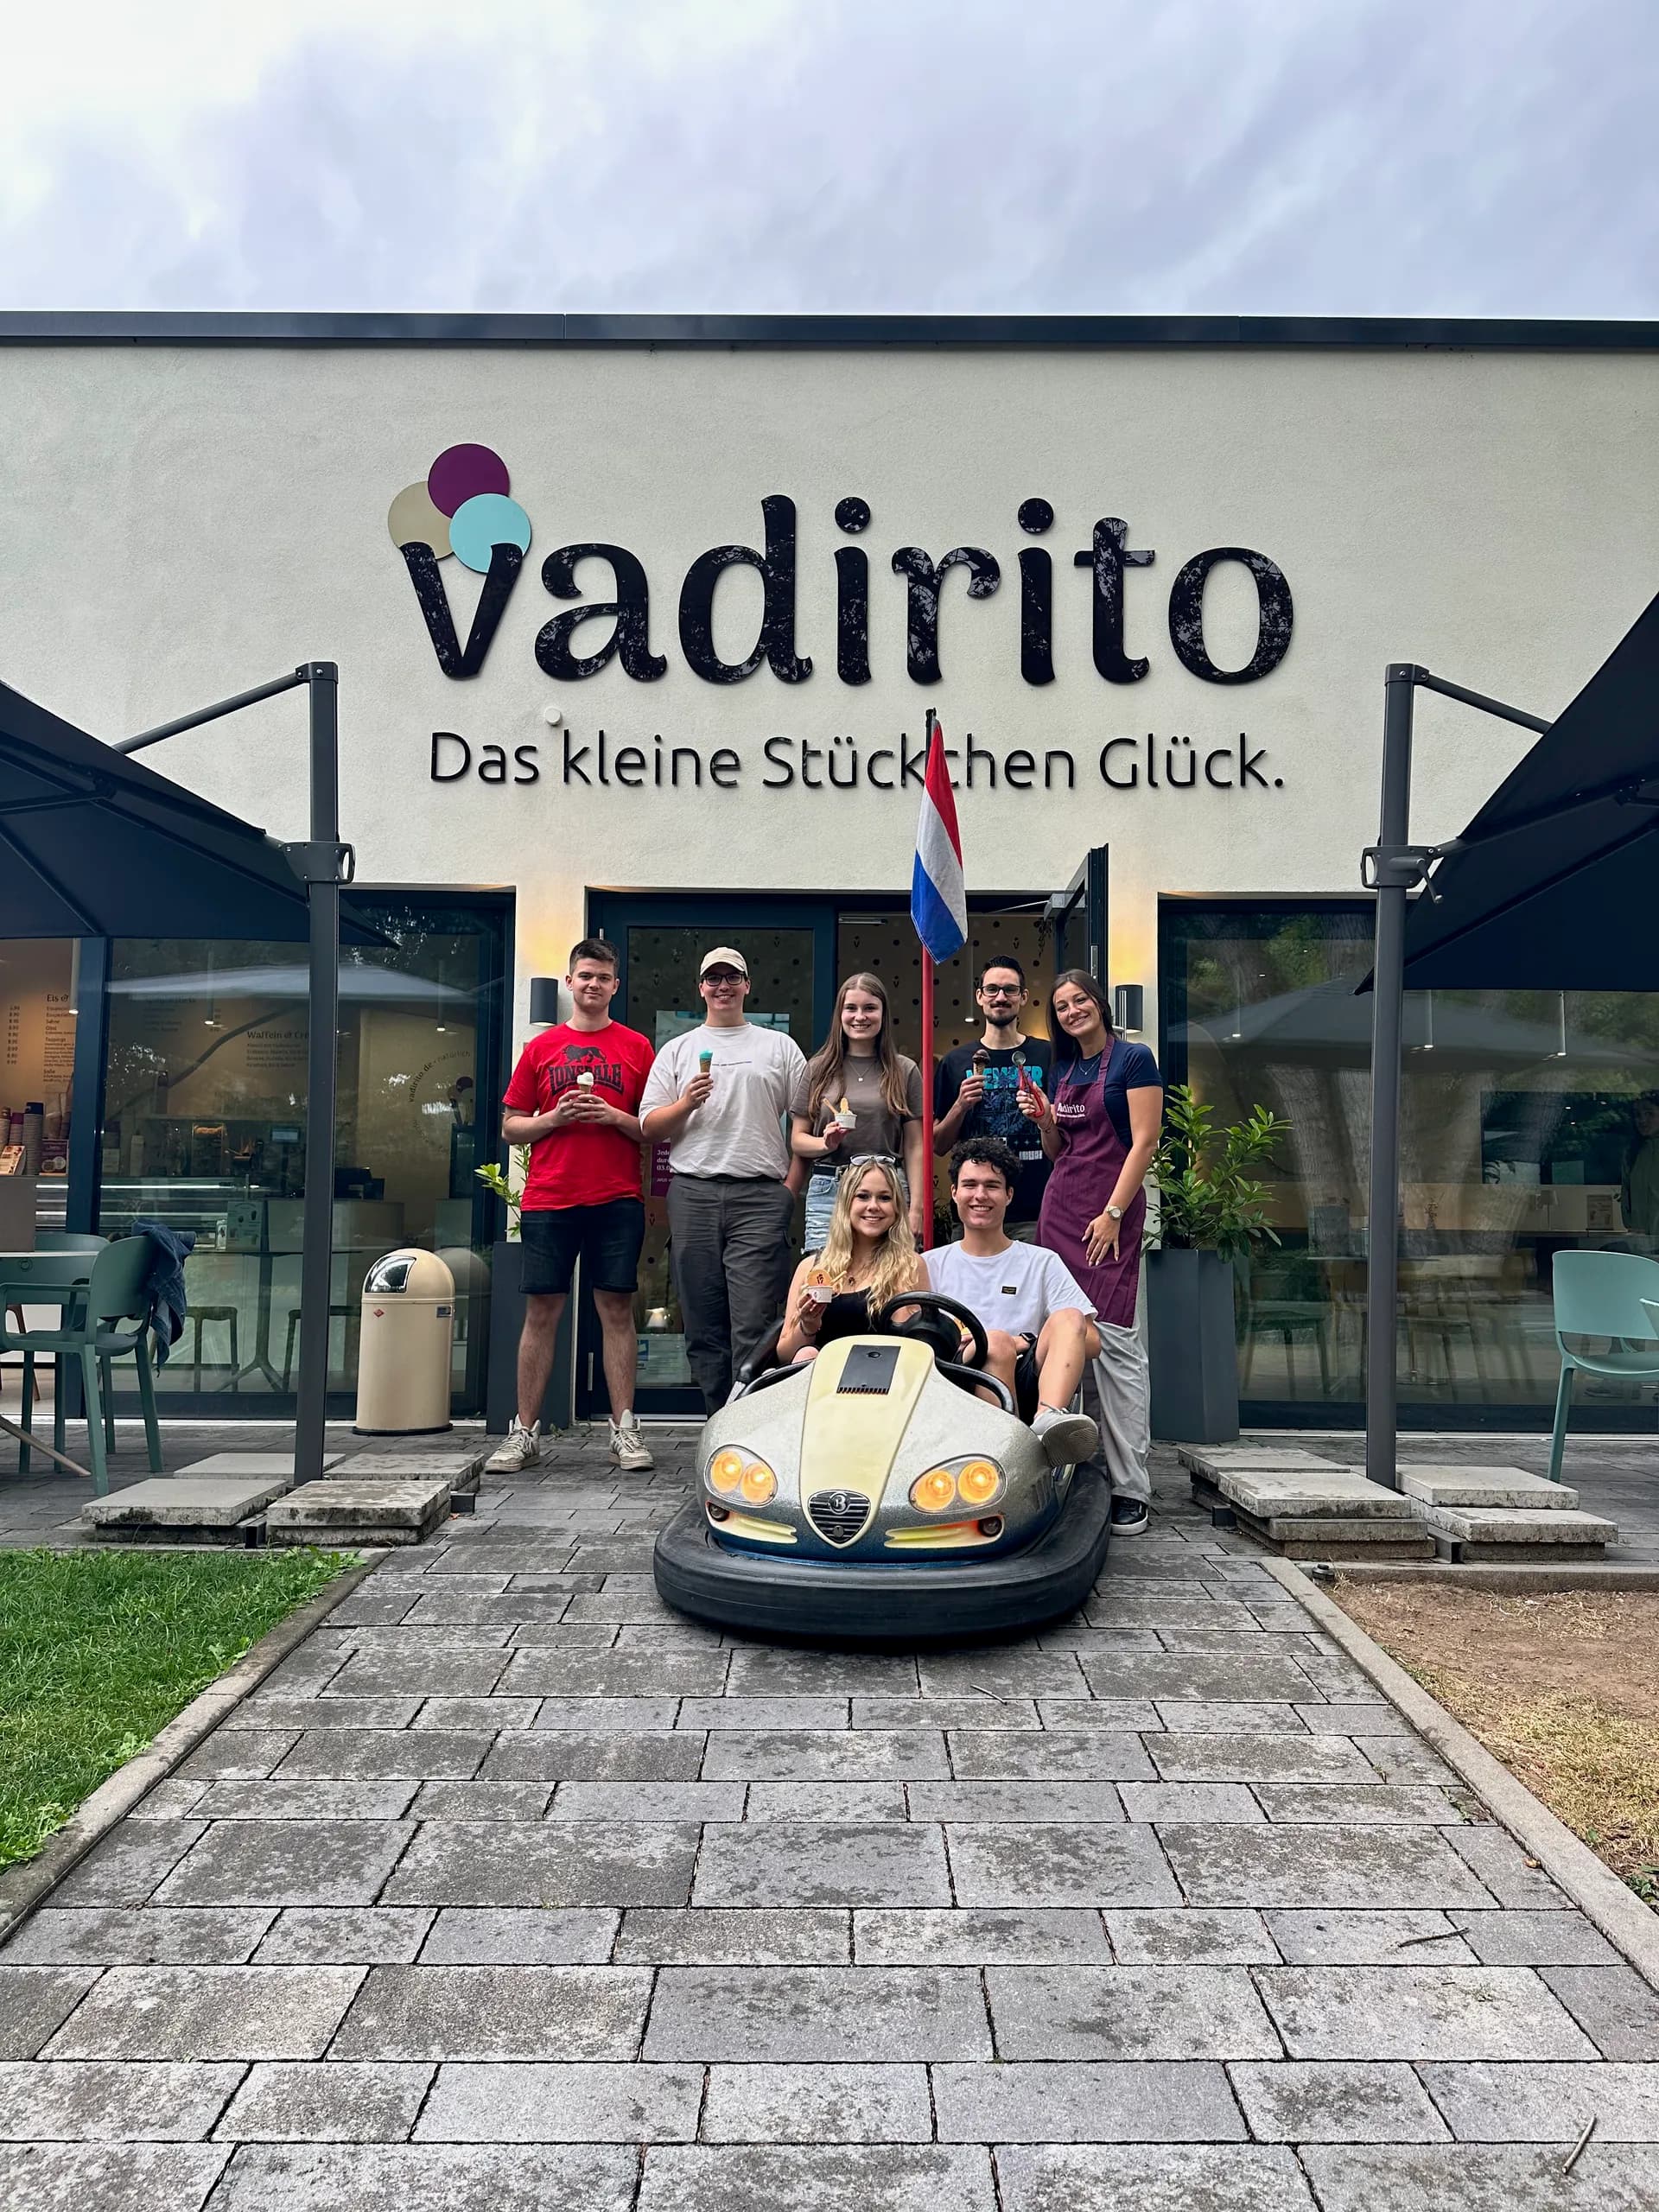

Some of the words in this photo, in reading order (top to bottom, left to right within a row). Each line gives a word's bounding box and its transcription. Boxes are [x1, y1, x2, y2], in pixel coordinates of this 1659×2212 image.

[400, 494, 1293, 684] vadirito
[431, 731, 541, 784] Das
[563, 728, 741, 788] kleine
[1099, 732, 1284, 788] Glück.
